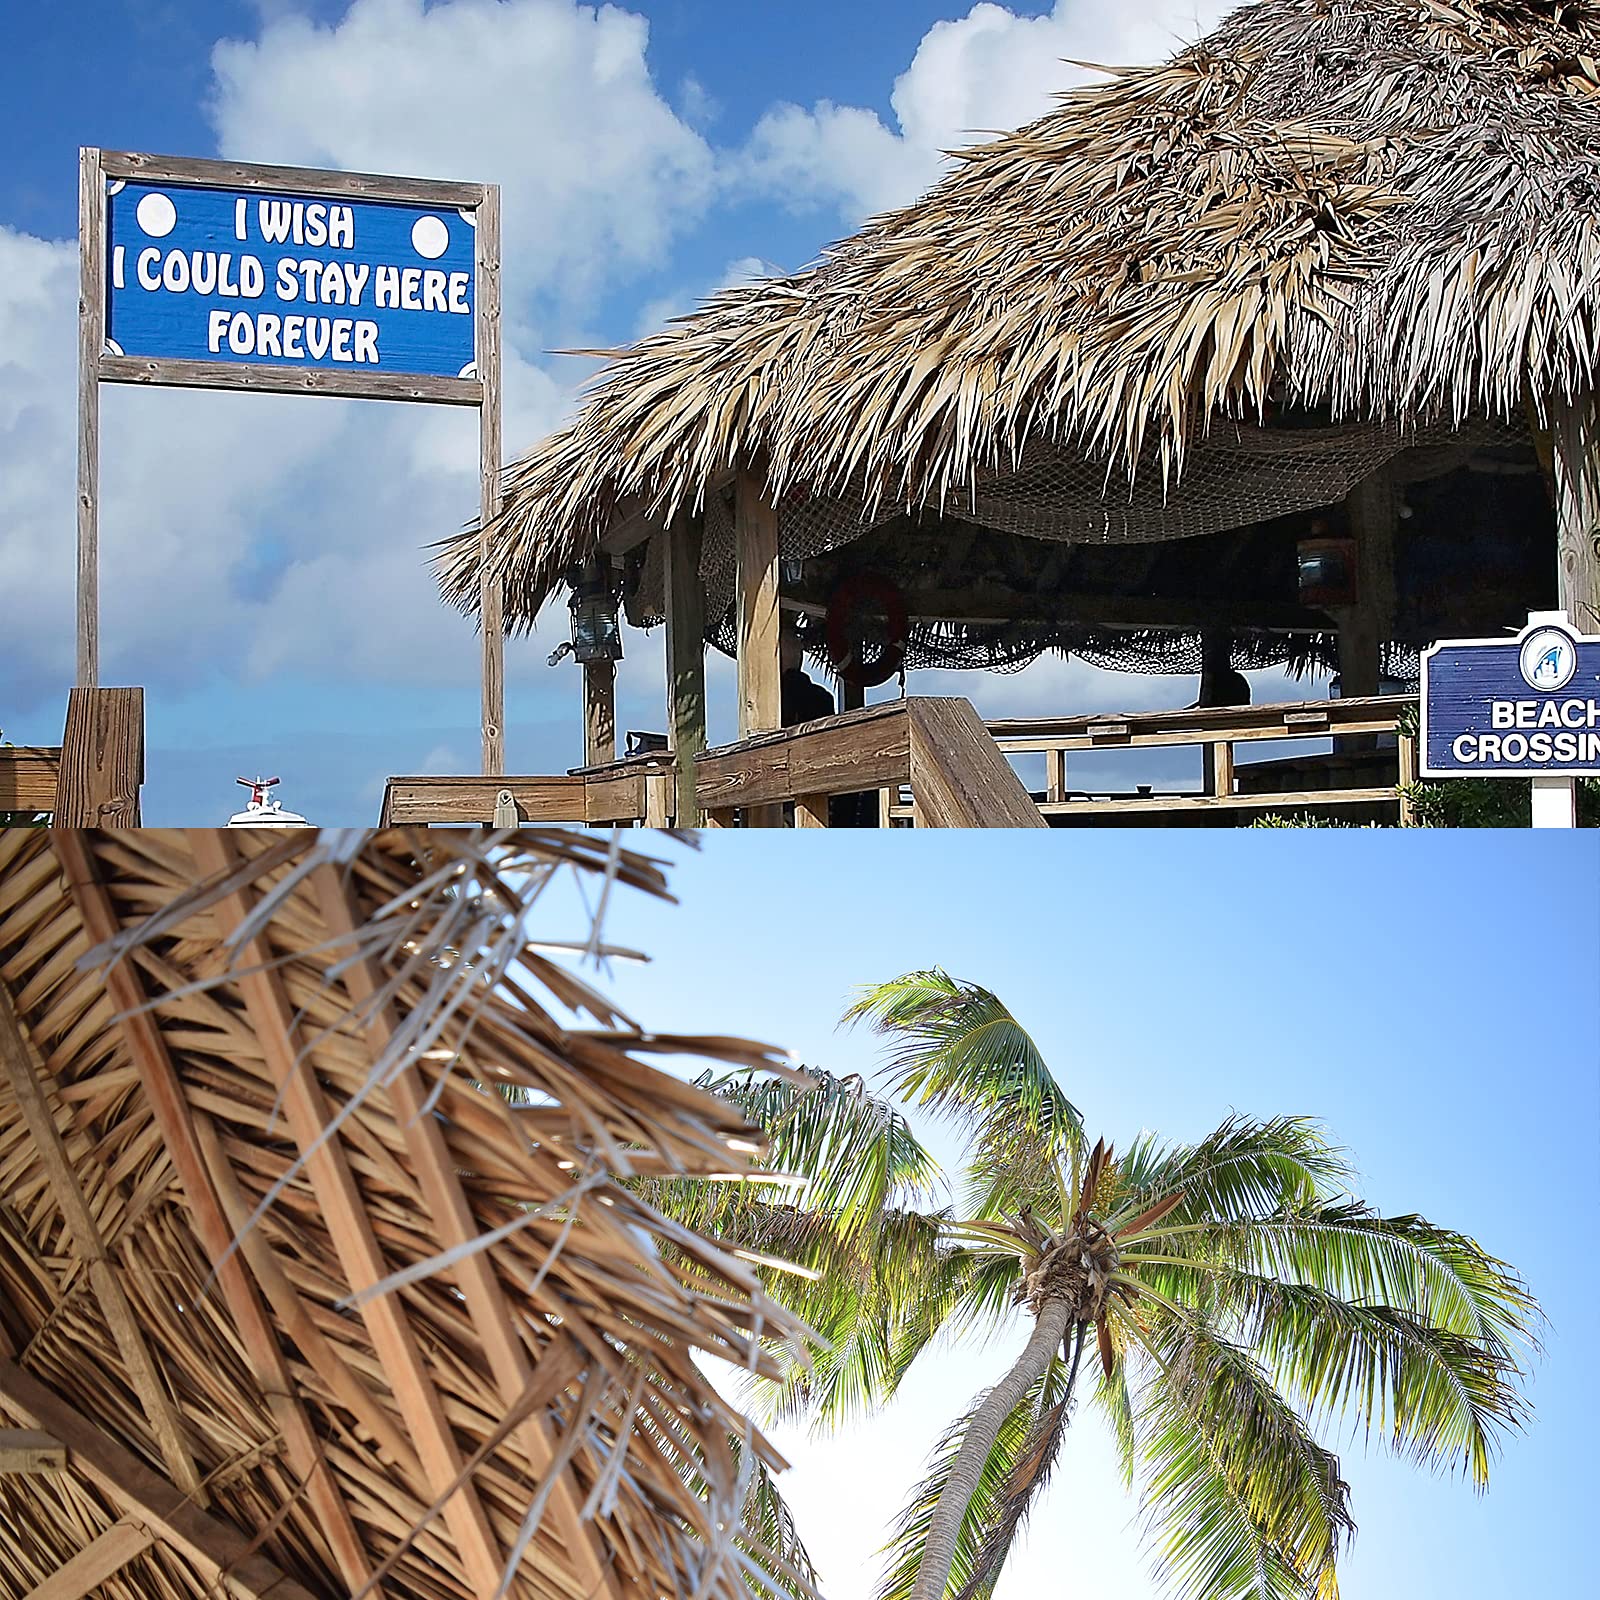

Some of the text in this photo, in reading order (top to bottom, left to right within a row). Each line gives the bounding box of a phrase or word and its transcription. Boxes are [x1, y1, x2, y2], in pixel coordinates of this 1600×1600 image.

[235, 198, 354, 249] I WISH
[113, 245, 470, 314] I COULD STAY HERE
[208, 310, 379, 364] FOREVER
